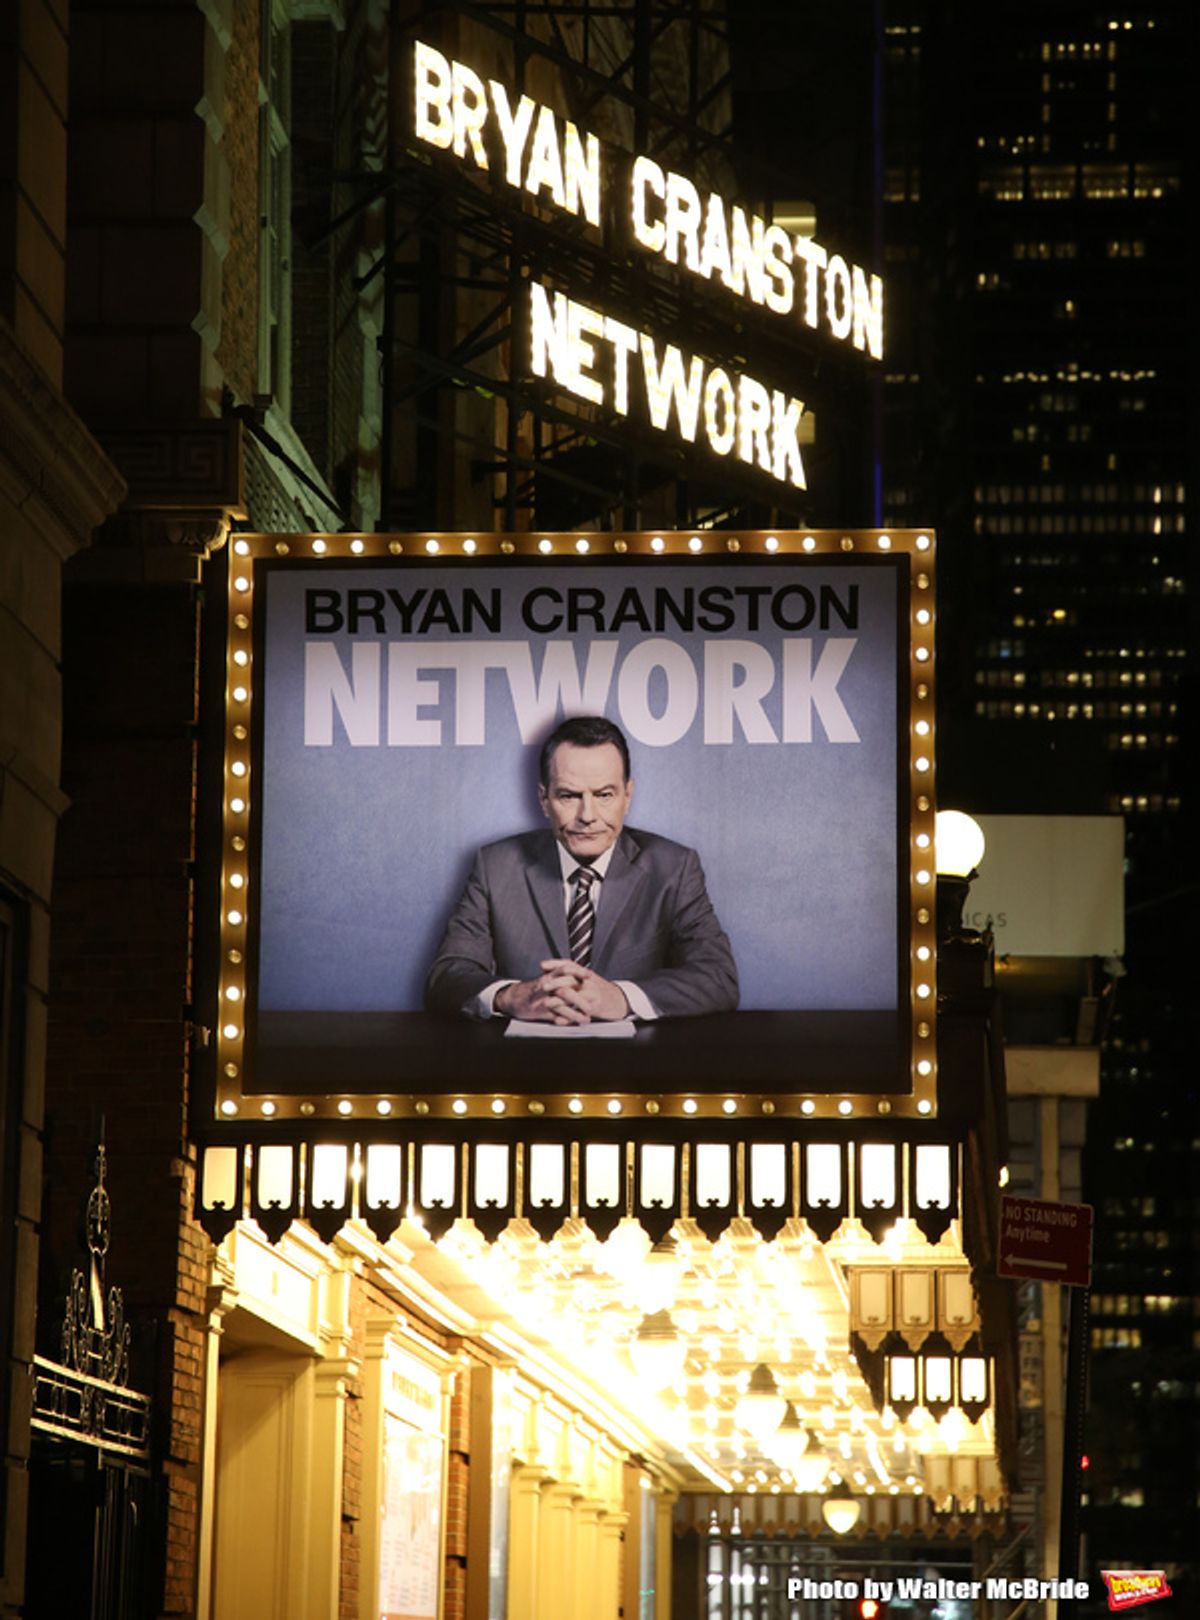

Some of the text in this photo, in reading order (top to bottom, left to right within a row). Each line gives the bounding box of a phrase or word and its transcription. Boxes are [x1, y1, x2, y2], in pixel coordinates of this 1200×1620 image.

[415, 39, 885, 361] BRYAN CRANSTON
[530, 281, 808, 491] NETWORK
[304, 584, 859, 634] BRYAN CRANSTON
[303, 637, 861, 747] NETWORK
[965, 911, 1008, 928] ICAS
[1005, 1223, 1050, 1243] Anytime
[1006, 1205, 1078, 1228] NO STANDING
